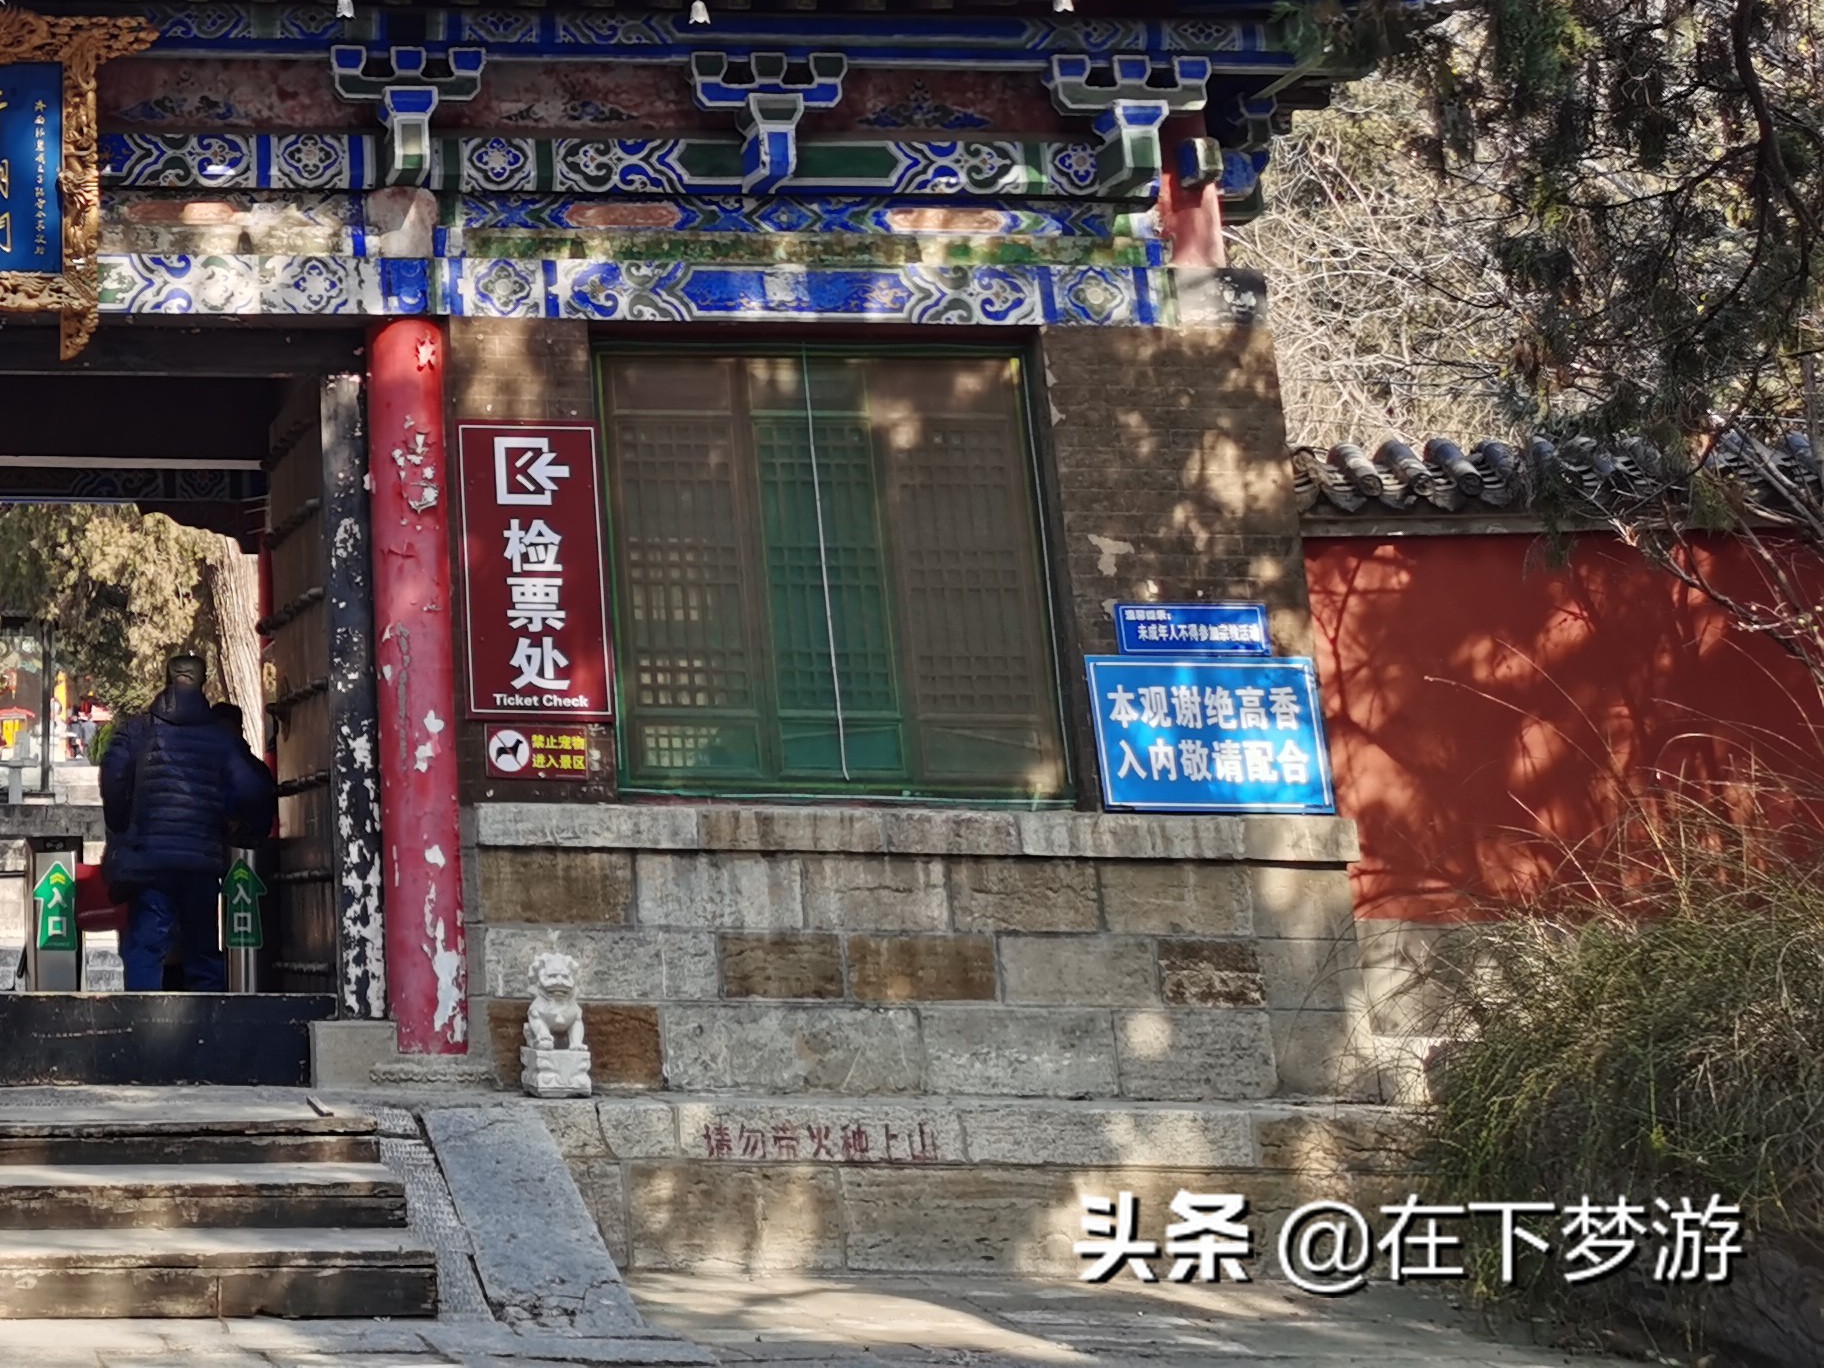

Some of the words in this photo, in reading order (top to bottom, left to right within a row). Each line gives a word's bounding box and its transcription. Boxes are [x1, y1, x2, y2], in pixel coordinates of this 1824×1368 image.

[503, 518, 570, 690] 检票处
[493, 693, 539, 706] Ticket
[542, 694, 588, 707] Check
[1107, 684, 1300, 730] 本观谢绝高香
[532, 734, 585, 750] 禁止宠物
[532, 753, 585, 770] 进入景区
[1117, 737, 1309, 784] 入内敬请配合
[47, 887, 68, 937] 入口
[232, 883, 252, 933] 入口
